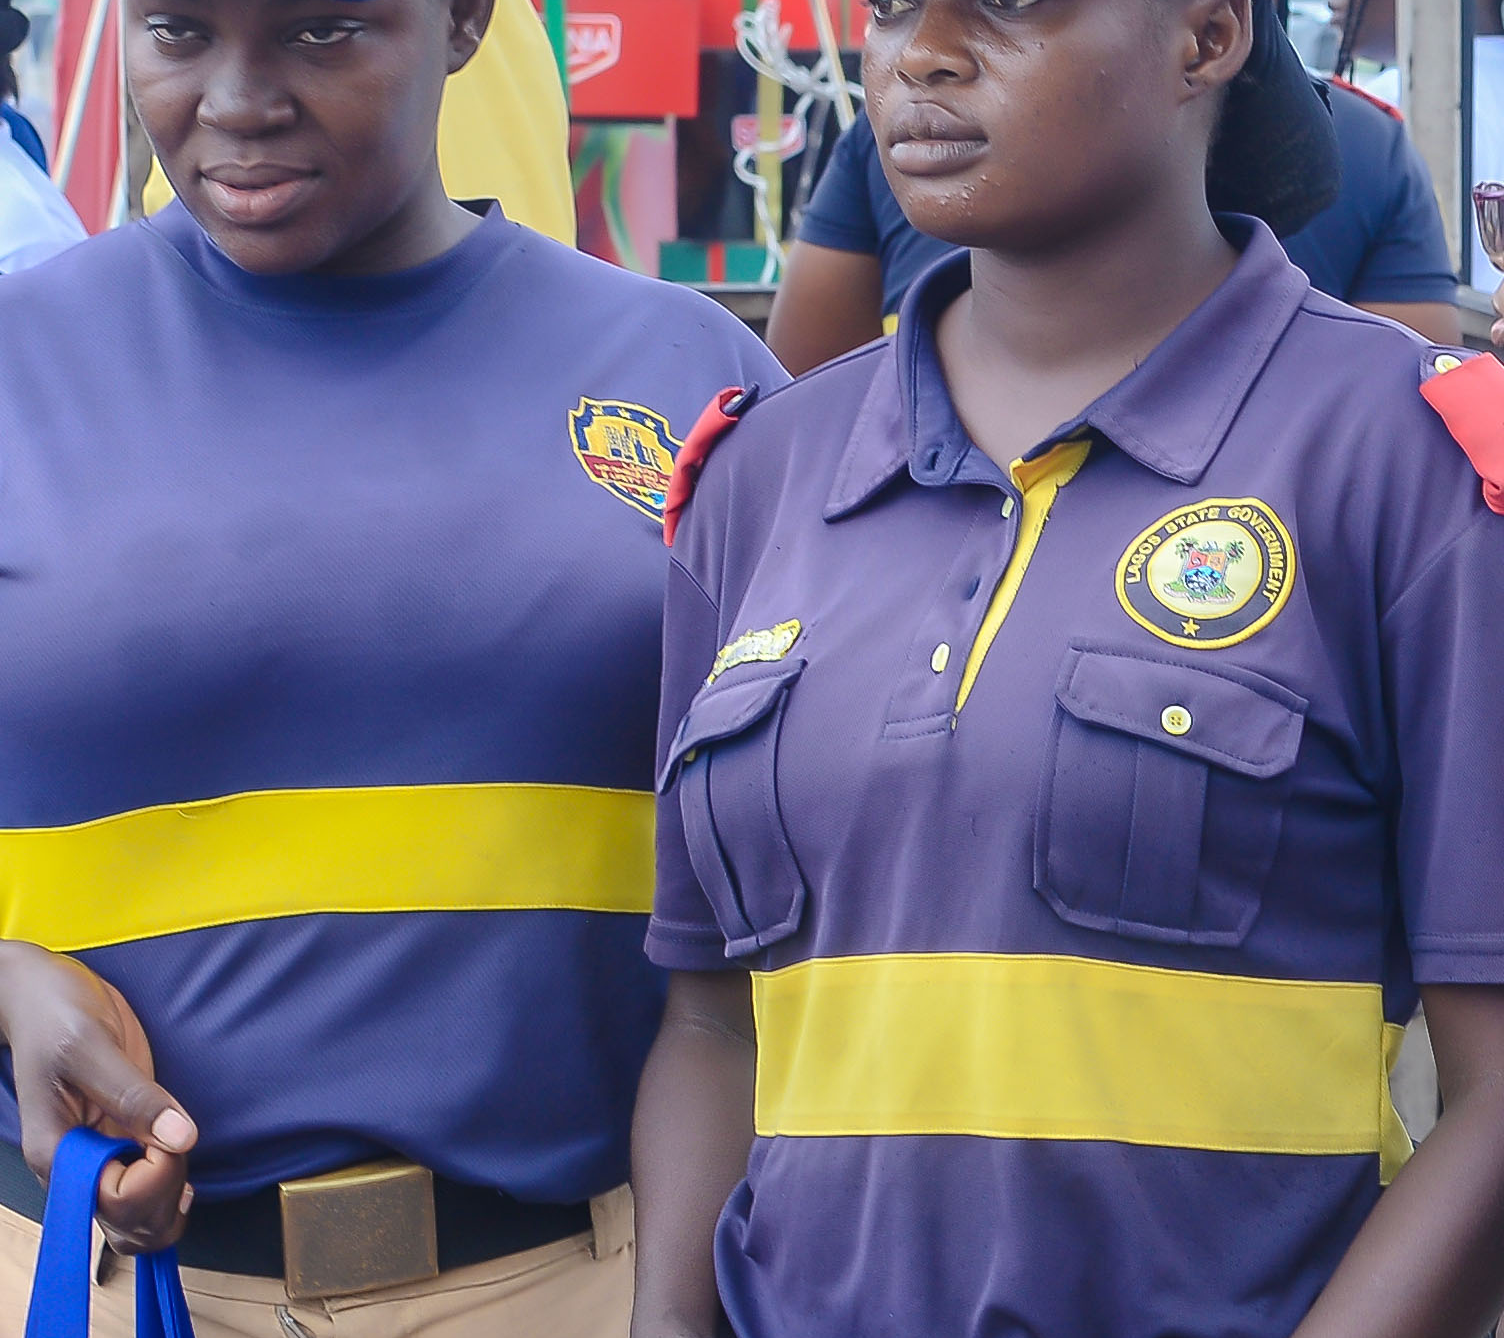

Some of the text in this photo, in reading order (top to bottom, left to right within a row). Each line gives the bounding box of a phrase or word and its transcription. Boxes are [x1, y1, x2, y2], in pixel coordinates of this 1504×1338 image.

[1126, 506, 1285, 604] LAGOS STATE GOVERNMENT
